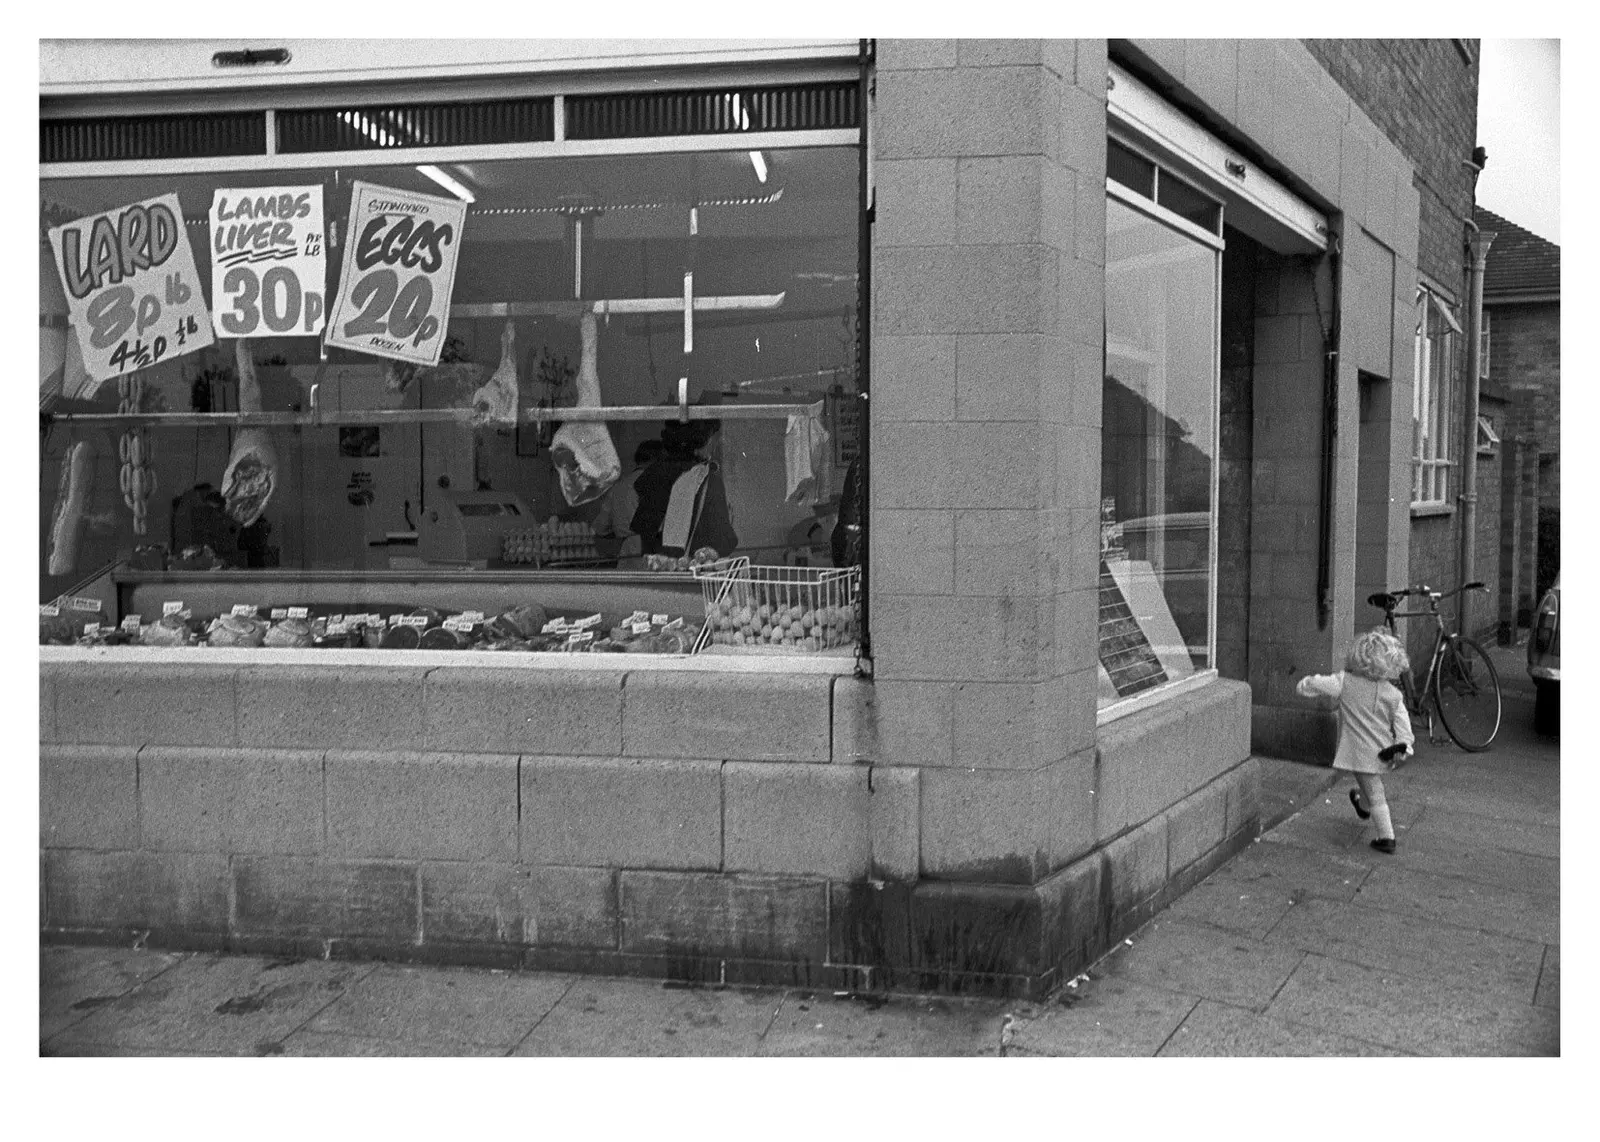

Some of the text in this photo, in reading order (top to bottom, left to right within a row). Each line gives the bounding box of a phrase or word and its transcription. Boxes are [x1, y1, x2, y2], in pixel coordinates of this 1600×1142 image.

[217, 193, 311, 221] LAMBS
[368, 199, 430, 214] STANDARD
[62, 203, 178, 299] LARD
[214, 222, 296, 254] LIVER
[304, 244, 321, 256] LB
[355, 215, 453, 274] EGGS
[165, 273, 192, 306] lb
